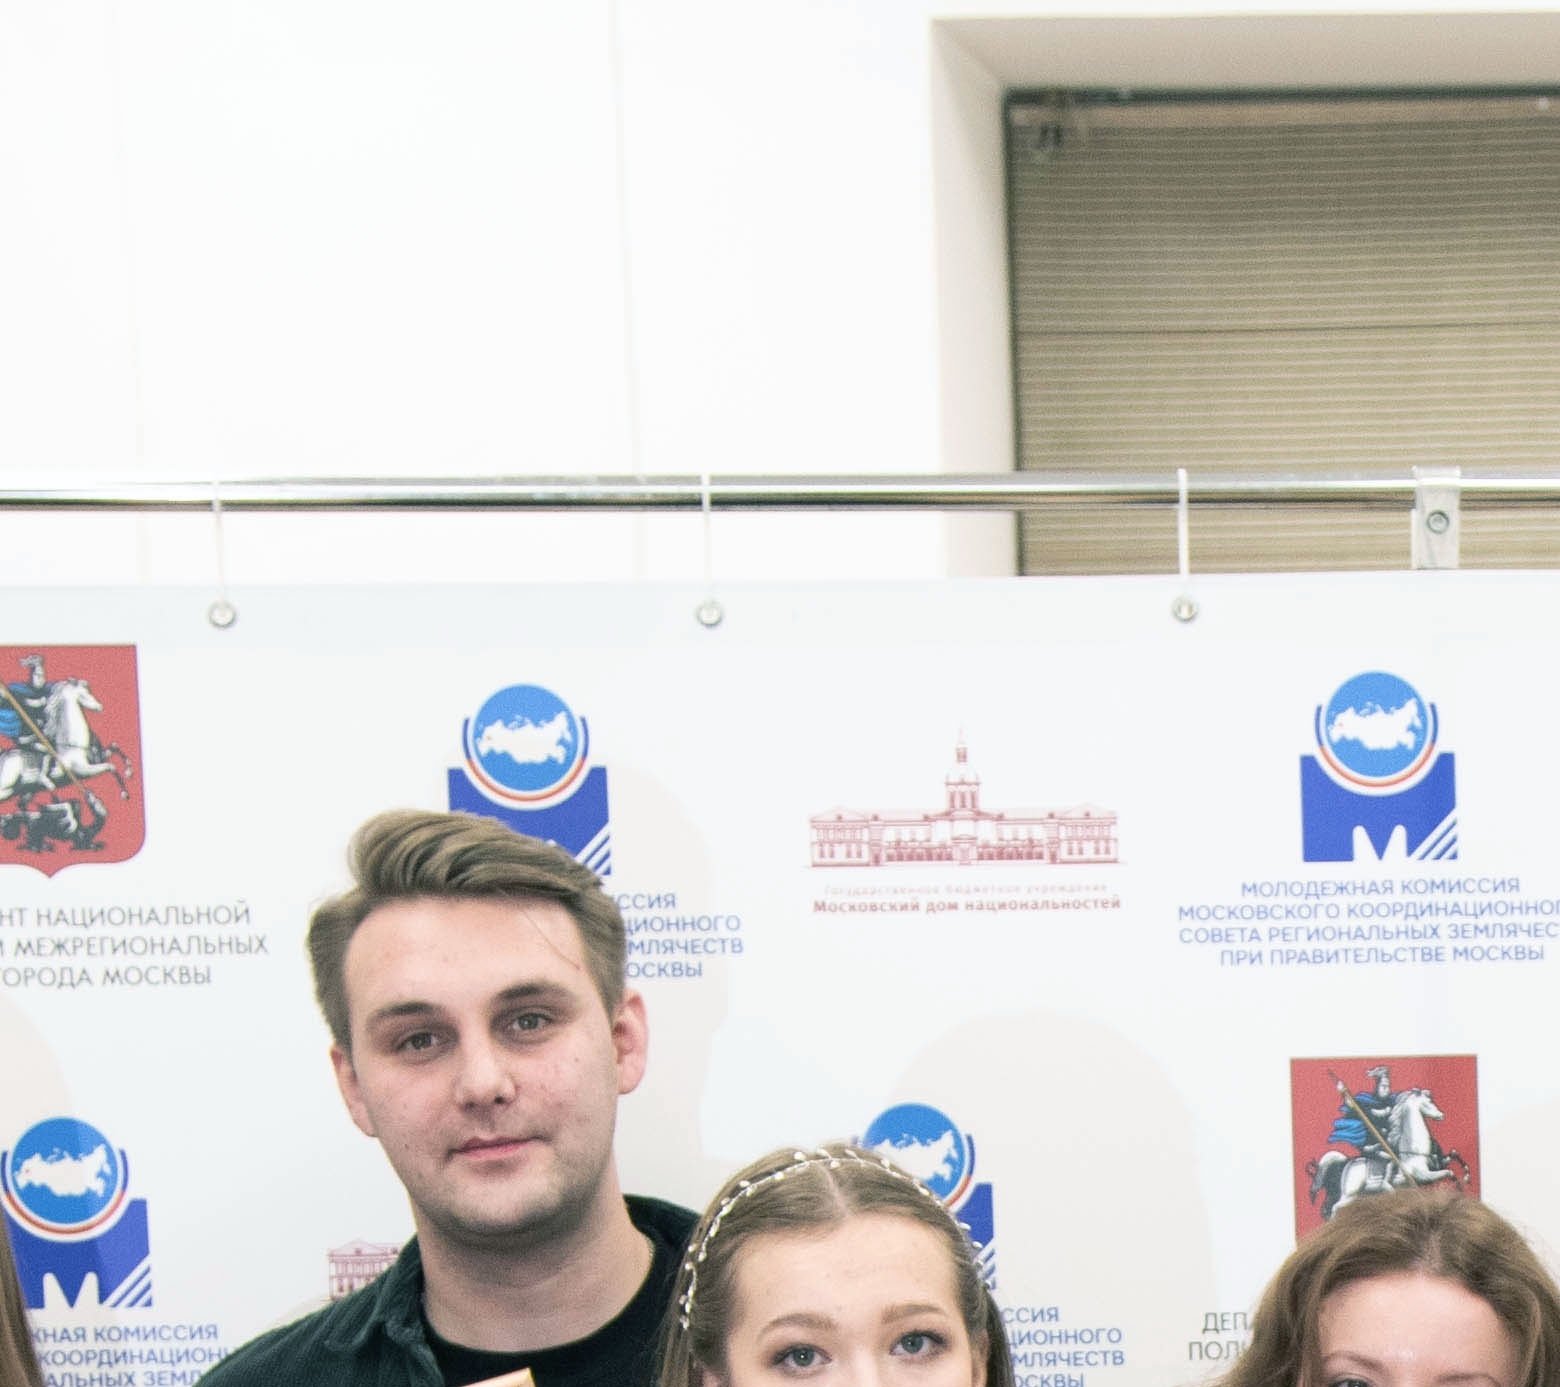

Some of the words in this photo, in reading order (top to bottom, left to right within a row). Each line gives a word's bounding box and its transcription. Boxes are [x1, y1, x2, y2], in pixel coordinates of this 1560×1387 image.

[1240, 879, 1395, 901] МОЛОДЕЖНАЯ
[1399, 877, 1521, 895] КОМИССИЯ
[34, 899, 252, 930] НАЦИОНАЛЬНОЙ
[812, 897, 921, 915] Московский
[925, 900, 960, 915] дом
[963, 894, 1121, 913] национальностей
[1177, 903, 1341, 921] МОСКОВСКОГО
[1178, 927, 1263, 945] СОВЕТА
[1267, 923, 1441, 943] РЕГИОНАЛЬНЫХ
[13, 934, 269, 958] МЕЖРЕГИОНАЛЬНЫХ
[1220, 949, 1264, 967] ПРИ
[1269, 945, 1447, 966] ПРАВИТЕЛЬСТВЕ
[1451, 944, 1545, 963] МОСКВЫ
[101, 964, 212, 987] МОСКВЫ
[93, 1323, 219, 1343] КОМИССИЯ
